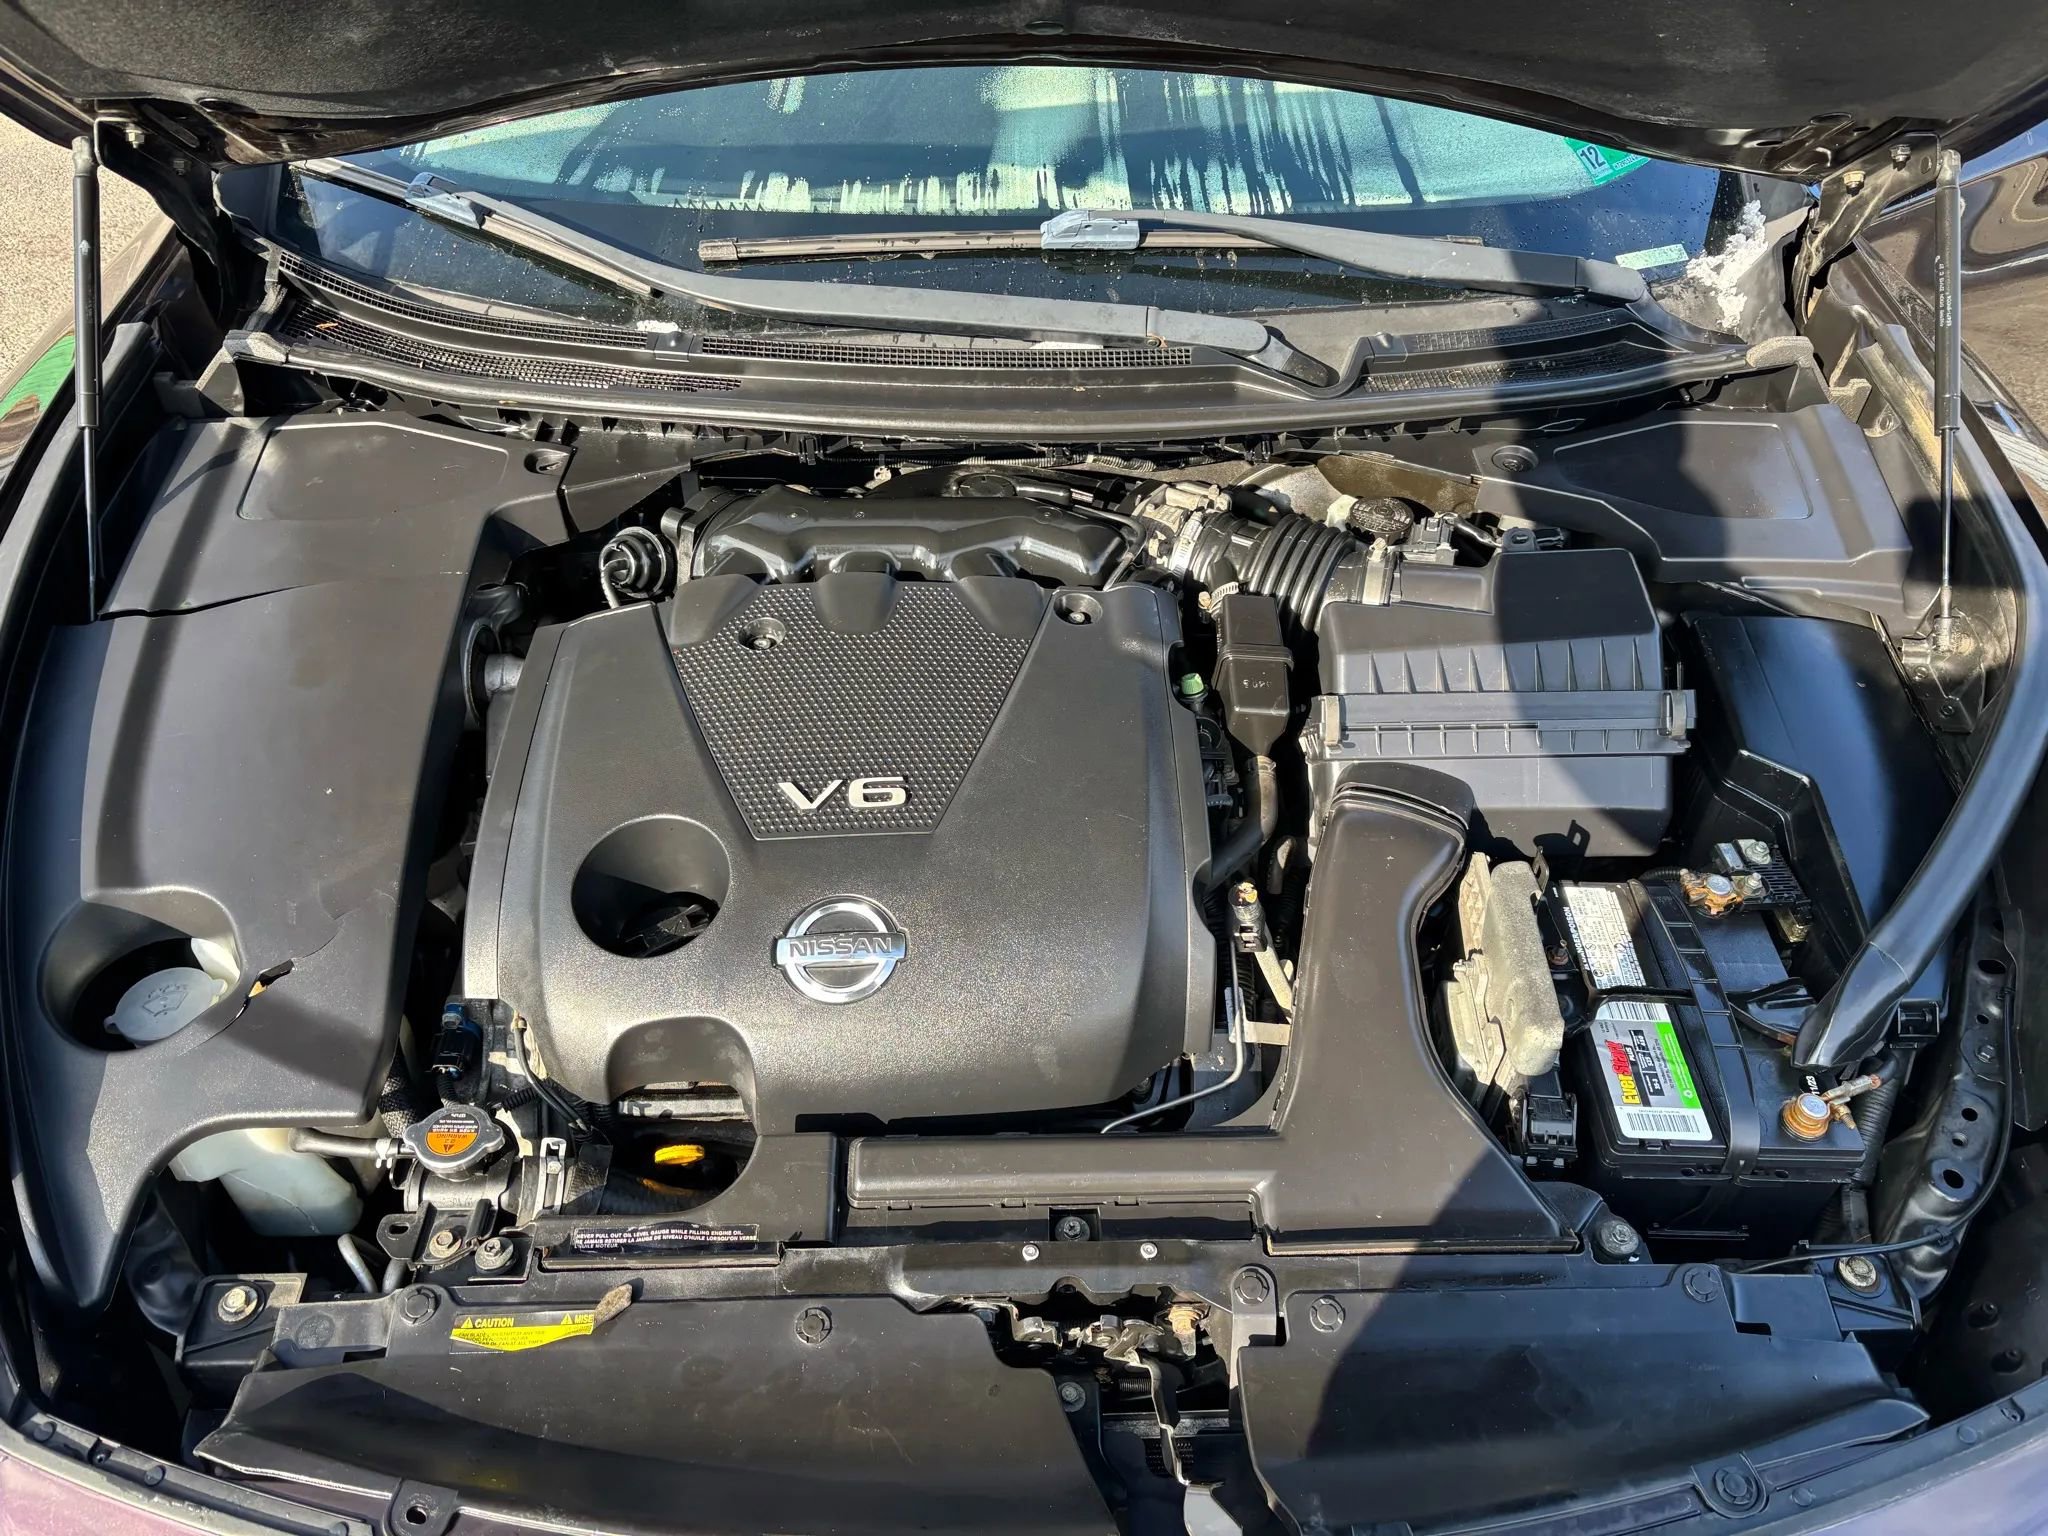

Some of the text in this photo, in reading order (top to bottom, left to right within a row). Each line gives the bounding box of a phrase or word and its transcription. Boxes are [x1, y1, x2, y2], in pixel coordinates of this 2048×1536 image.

[1579, 145, 1606, 170] 12
[778, 776, 908, 810] V6
[788, 936, 892, 959] NISSAN
[1625, 1046, 1636, 1062] PLUS
[1604, 1040, 1641, 1104] EverStart
[1806, 1075, 1820, 1096] 11/23
[474, 1317, 515, 1328] CAUTION
[574, 1314, 594, 1324] MISE
